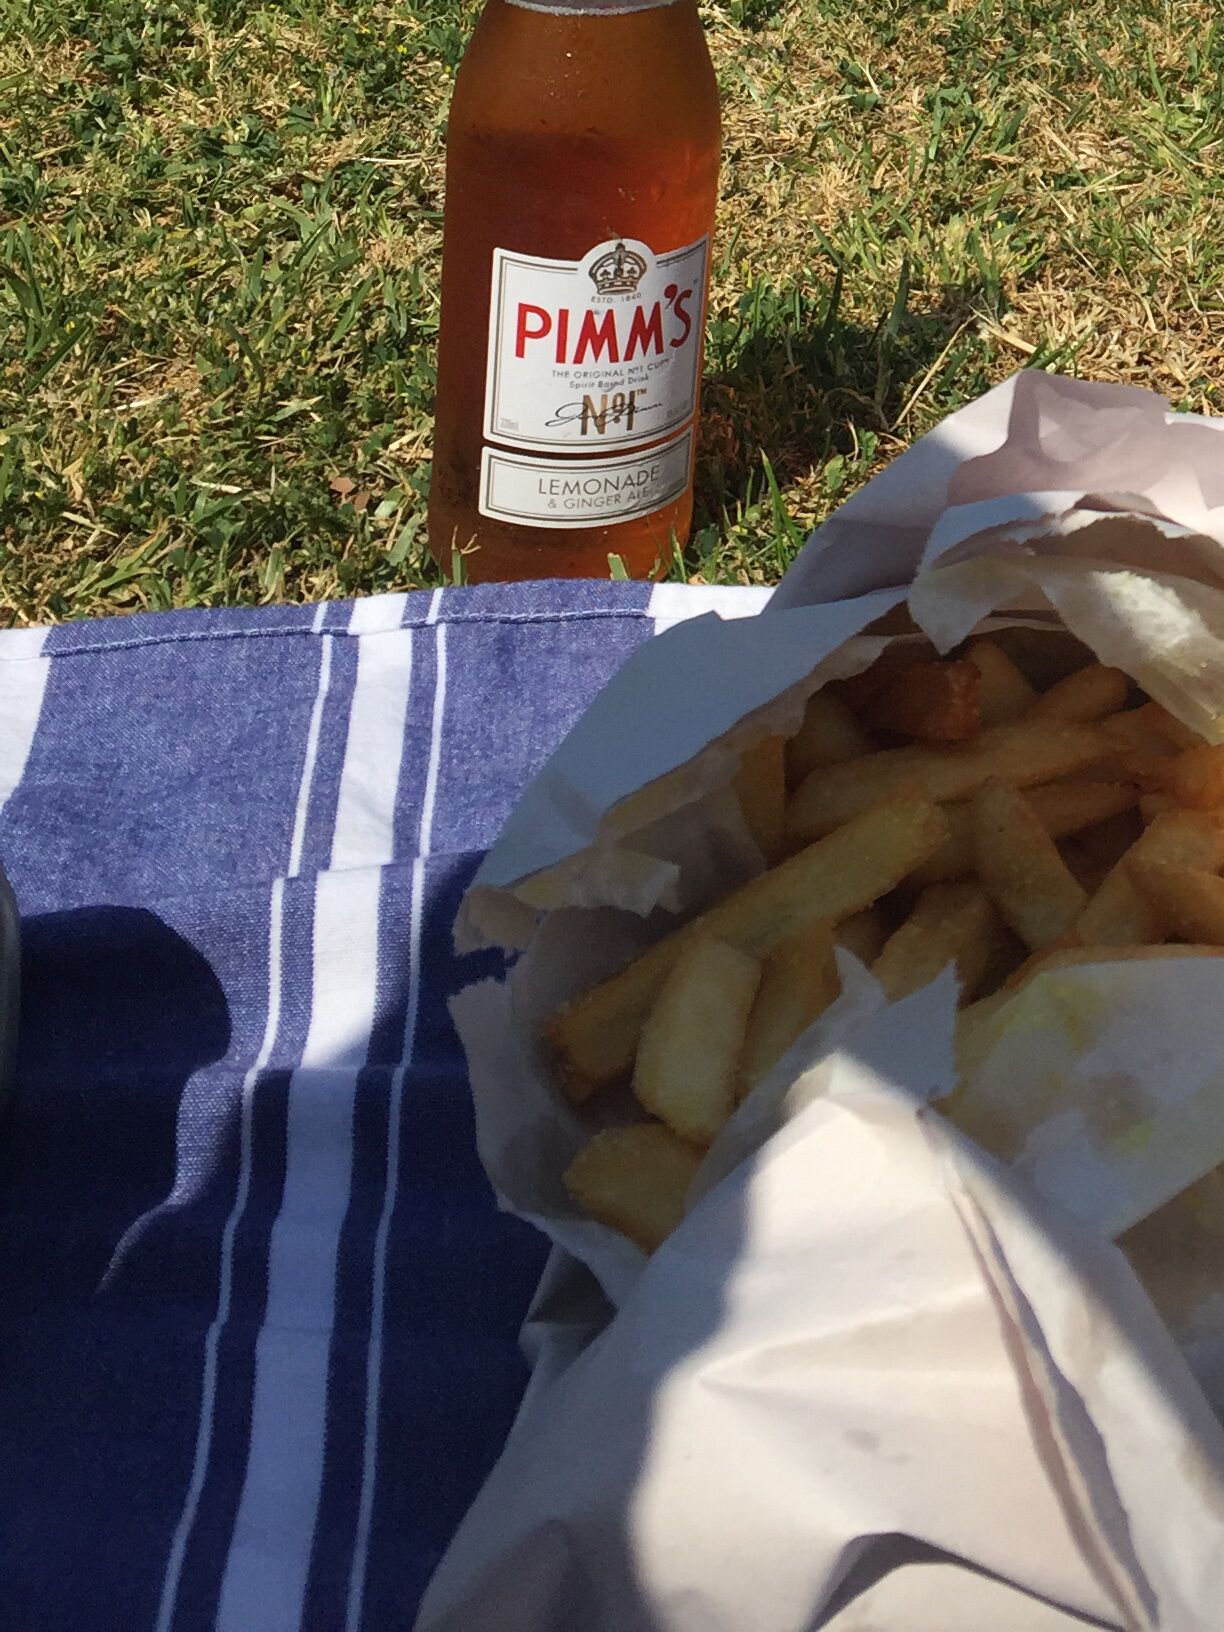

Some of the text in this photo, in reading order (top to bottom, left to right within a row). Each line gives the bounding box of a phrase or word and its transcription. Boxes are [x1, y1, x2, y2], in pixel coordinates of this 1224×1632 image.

[514, 283, 693, 364] PIMM'S
[551, 369, 570, 379] THE
[573, 369, 623, 379] ORIGINAL
[538, 465, 660, 495] LEMONADE
[547, 486, 650, 509] & GINGER ALE
